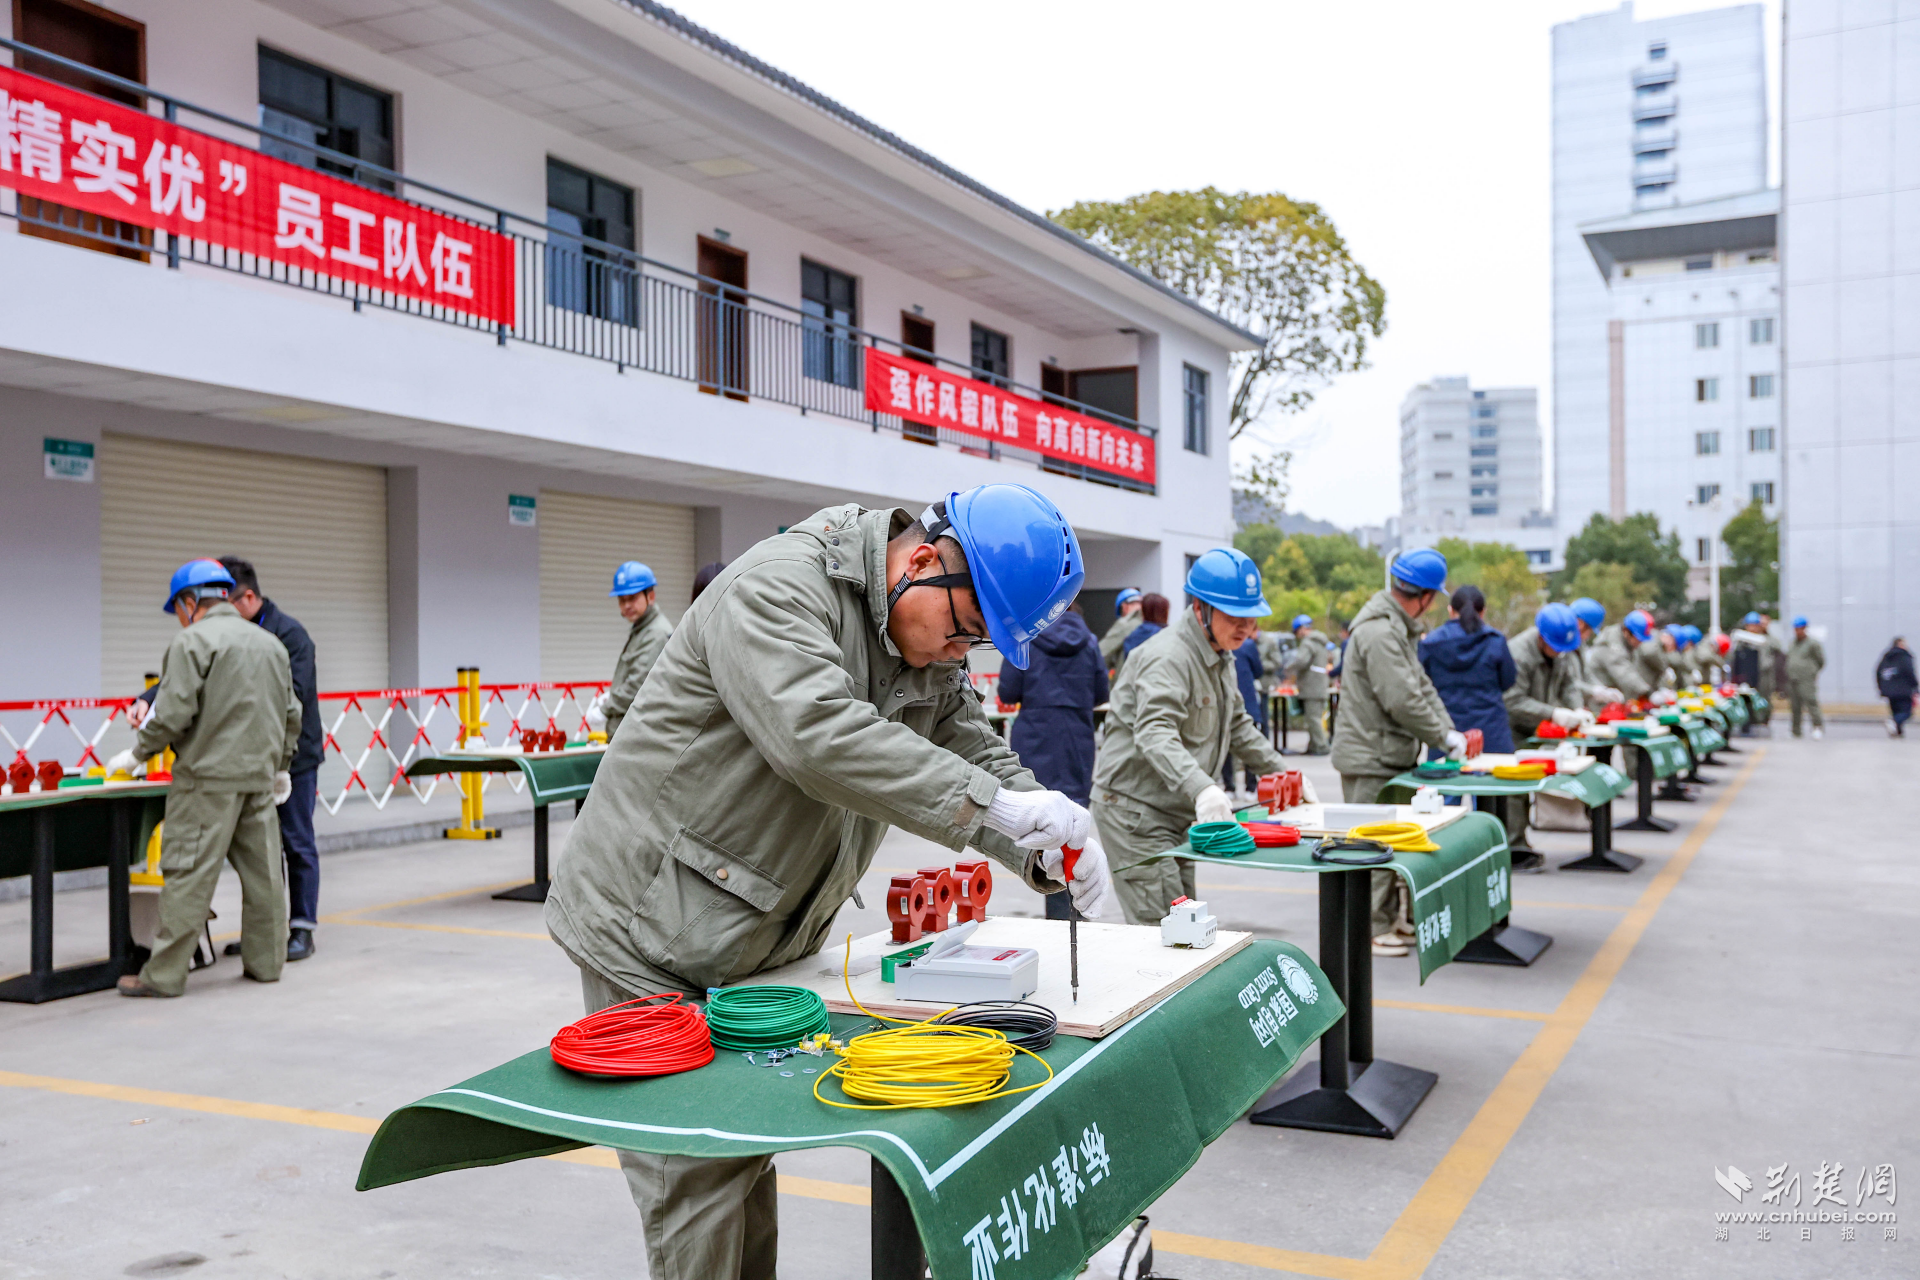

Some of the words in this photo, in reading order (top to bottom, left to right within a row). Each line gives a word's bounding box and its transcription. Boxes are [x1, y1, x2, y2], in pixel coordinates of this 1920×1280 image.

[962, 1121, 1112, 1280] 标准化作业
